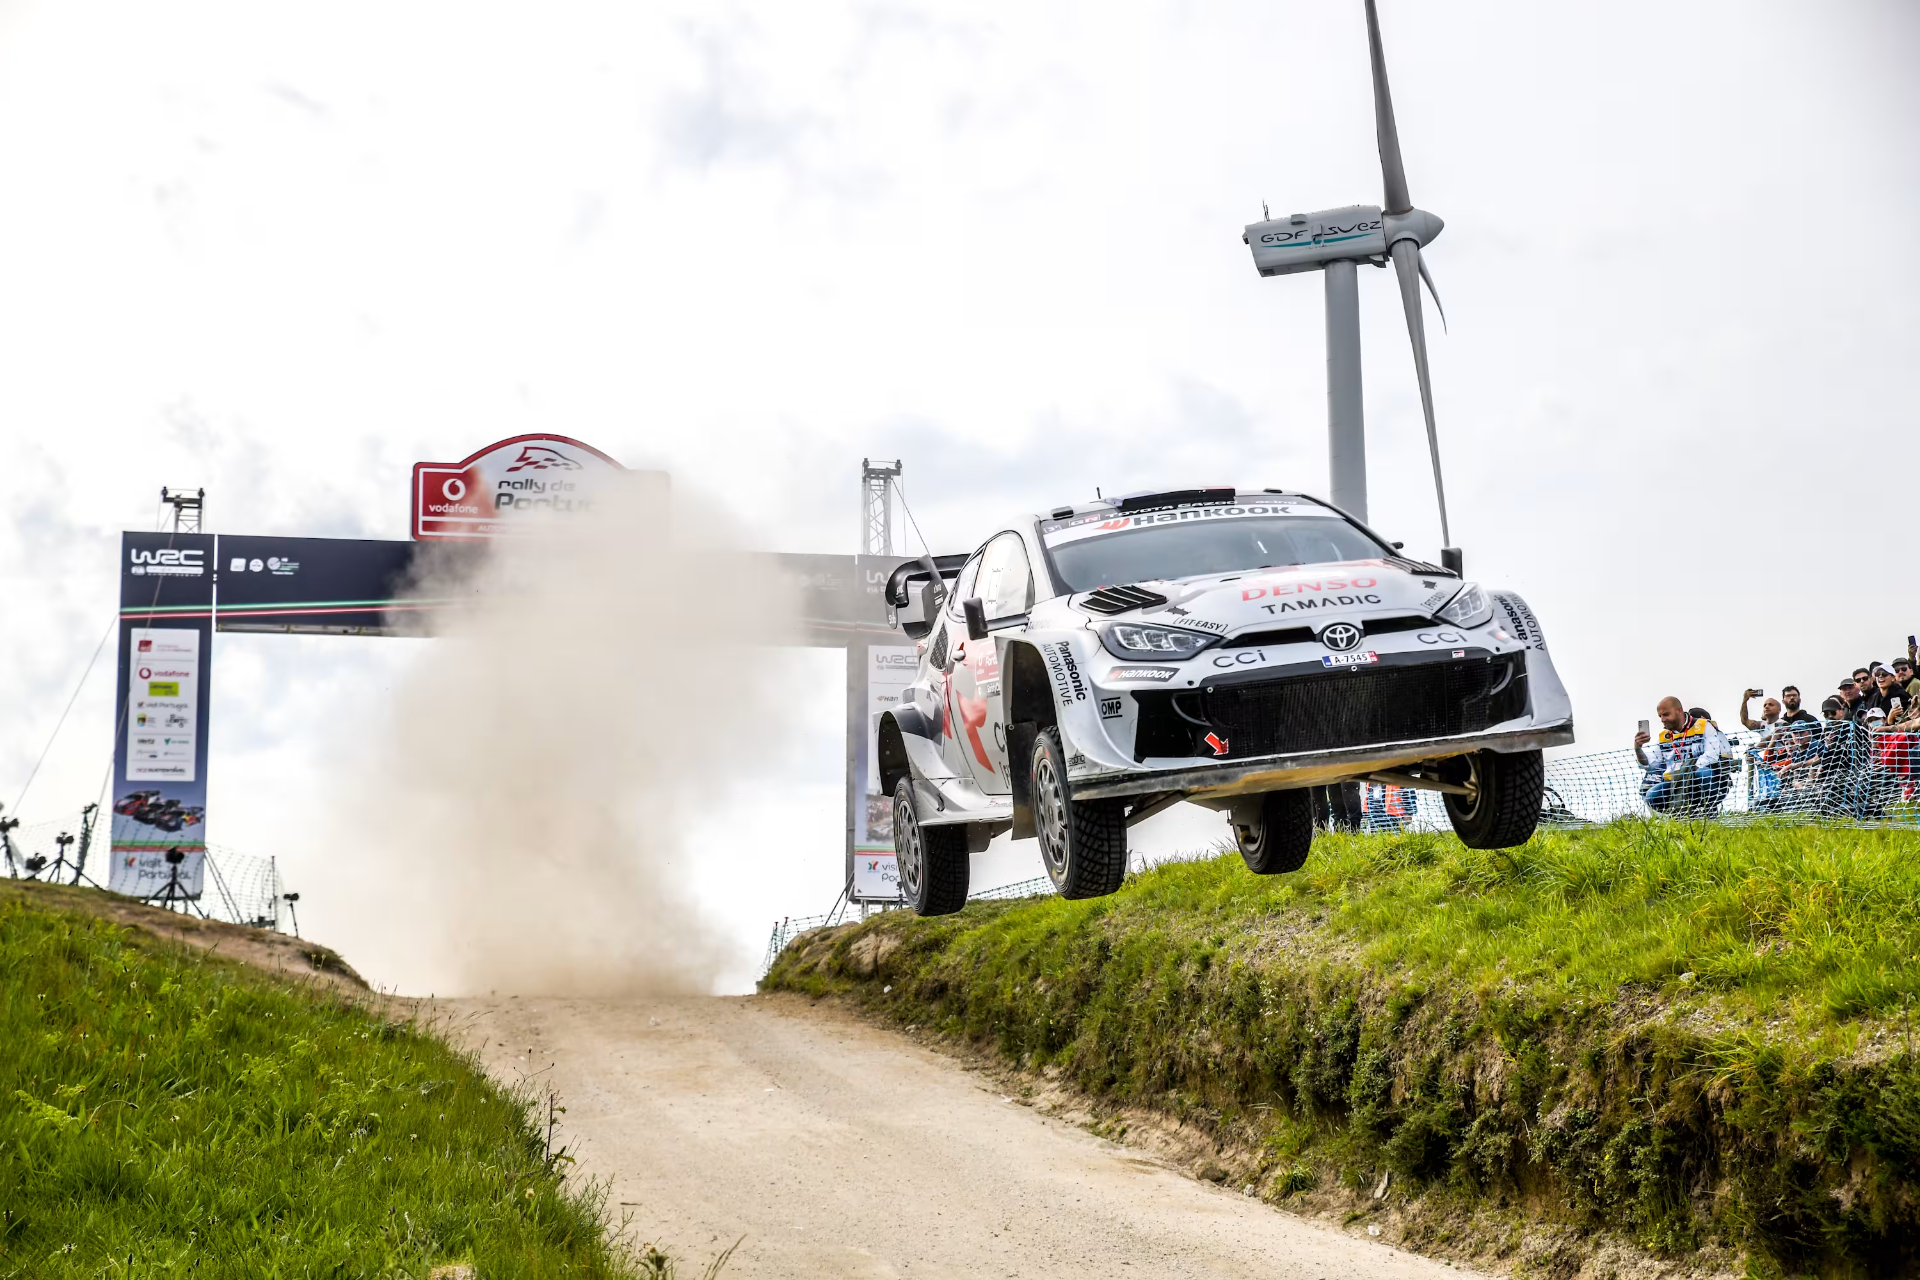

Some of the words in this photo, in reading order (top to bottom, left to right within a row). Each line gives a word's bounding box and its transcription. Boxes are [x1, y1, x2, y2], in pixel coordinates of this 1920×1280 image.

[1260, 229, 1308, 244] GDF
[497, 478, 547, 494] rally
[550, 478, 577, 492] de
[428, 503, 479, 515] vodafone
[494, 492, 597, 513] Portu
[1104, 504, 1176, 518] TOYOTA
[130, 548, 205, 566] WRC
[1241, 577, 1378, 602] DENSO
[1261, 594, 1382, 615] TAMADIC
[1493, 594, 1531, 650] anasonic
[1334, 653, 1368, 664] A-7545
[154, 670, 190, 678] vodafone
[1040, 643, 1074, 707] AUTOMOTIVE
[1055, 640, 1086, 702] Panasonic
[1101, 700, 1123, 716] OMP
[139, 858, 162, 867] visit
[881, 861, 899, 872] visi
[138, 869, 192, 881] Portual
[881, 873, 900, 883] Por
